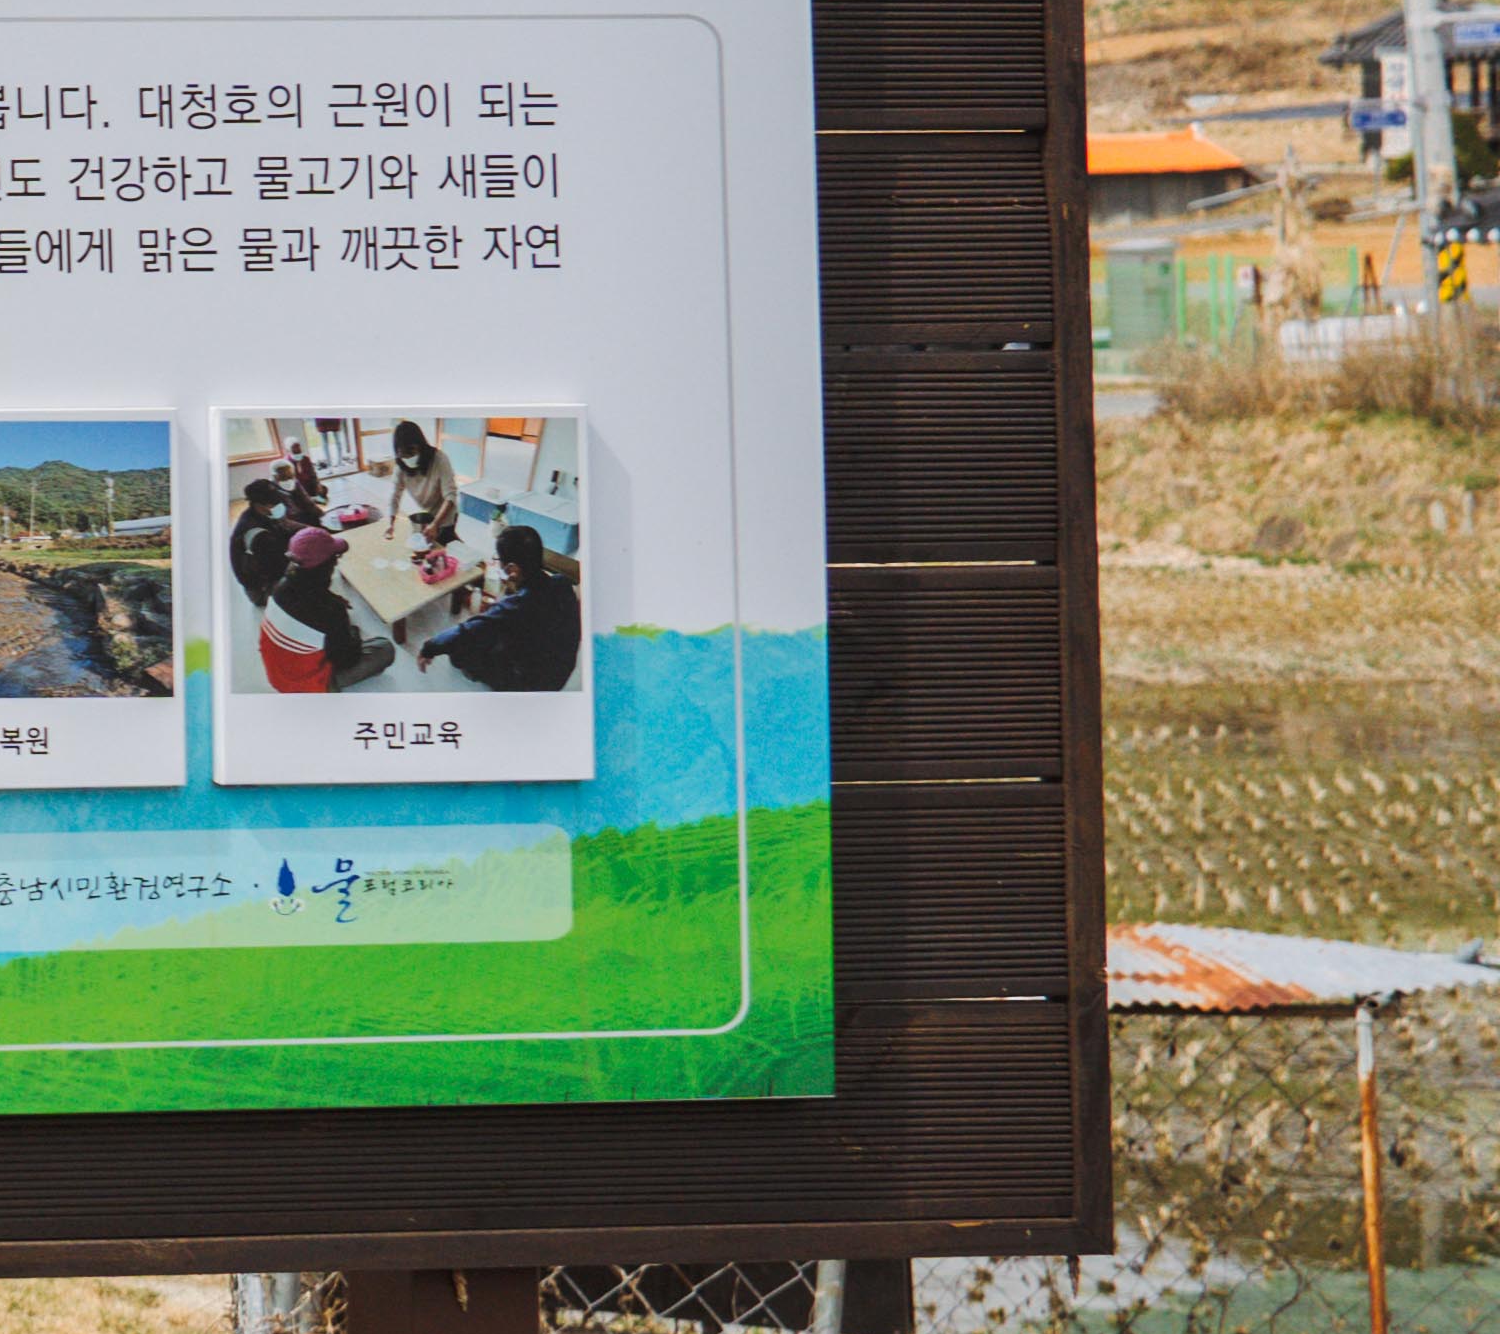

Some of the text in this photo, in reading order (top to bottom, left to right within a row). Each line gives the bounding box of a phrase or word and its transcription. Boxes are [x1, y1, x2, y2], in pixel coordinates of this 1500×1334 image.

[138, 83, 302, 130] 대청호의
[328, 82, 450, 128] 근원이
[478, 82, 559, 128] 되는
[68, 155, 233, 203] 건강하고
[253, 154, 419, 201] 물고기와
[438, 152, 558, 199] 새들이
[138, 227, 218, 274] 맑은
[238, 226, 321, 272] 물과
[340, 225, 463, 271] 깨끗한
[482, 224, 561, 270] 자연
[353, 721, 463, 750] 주민교육
